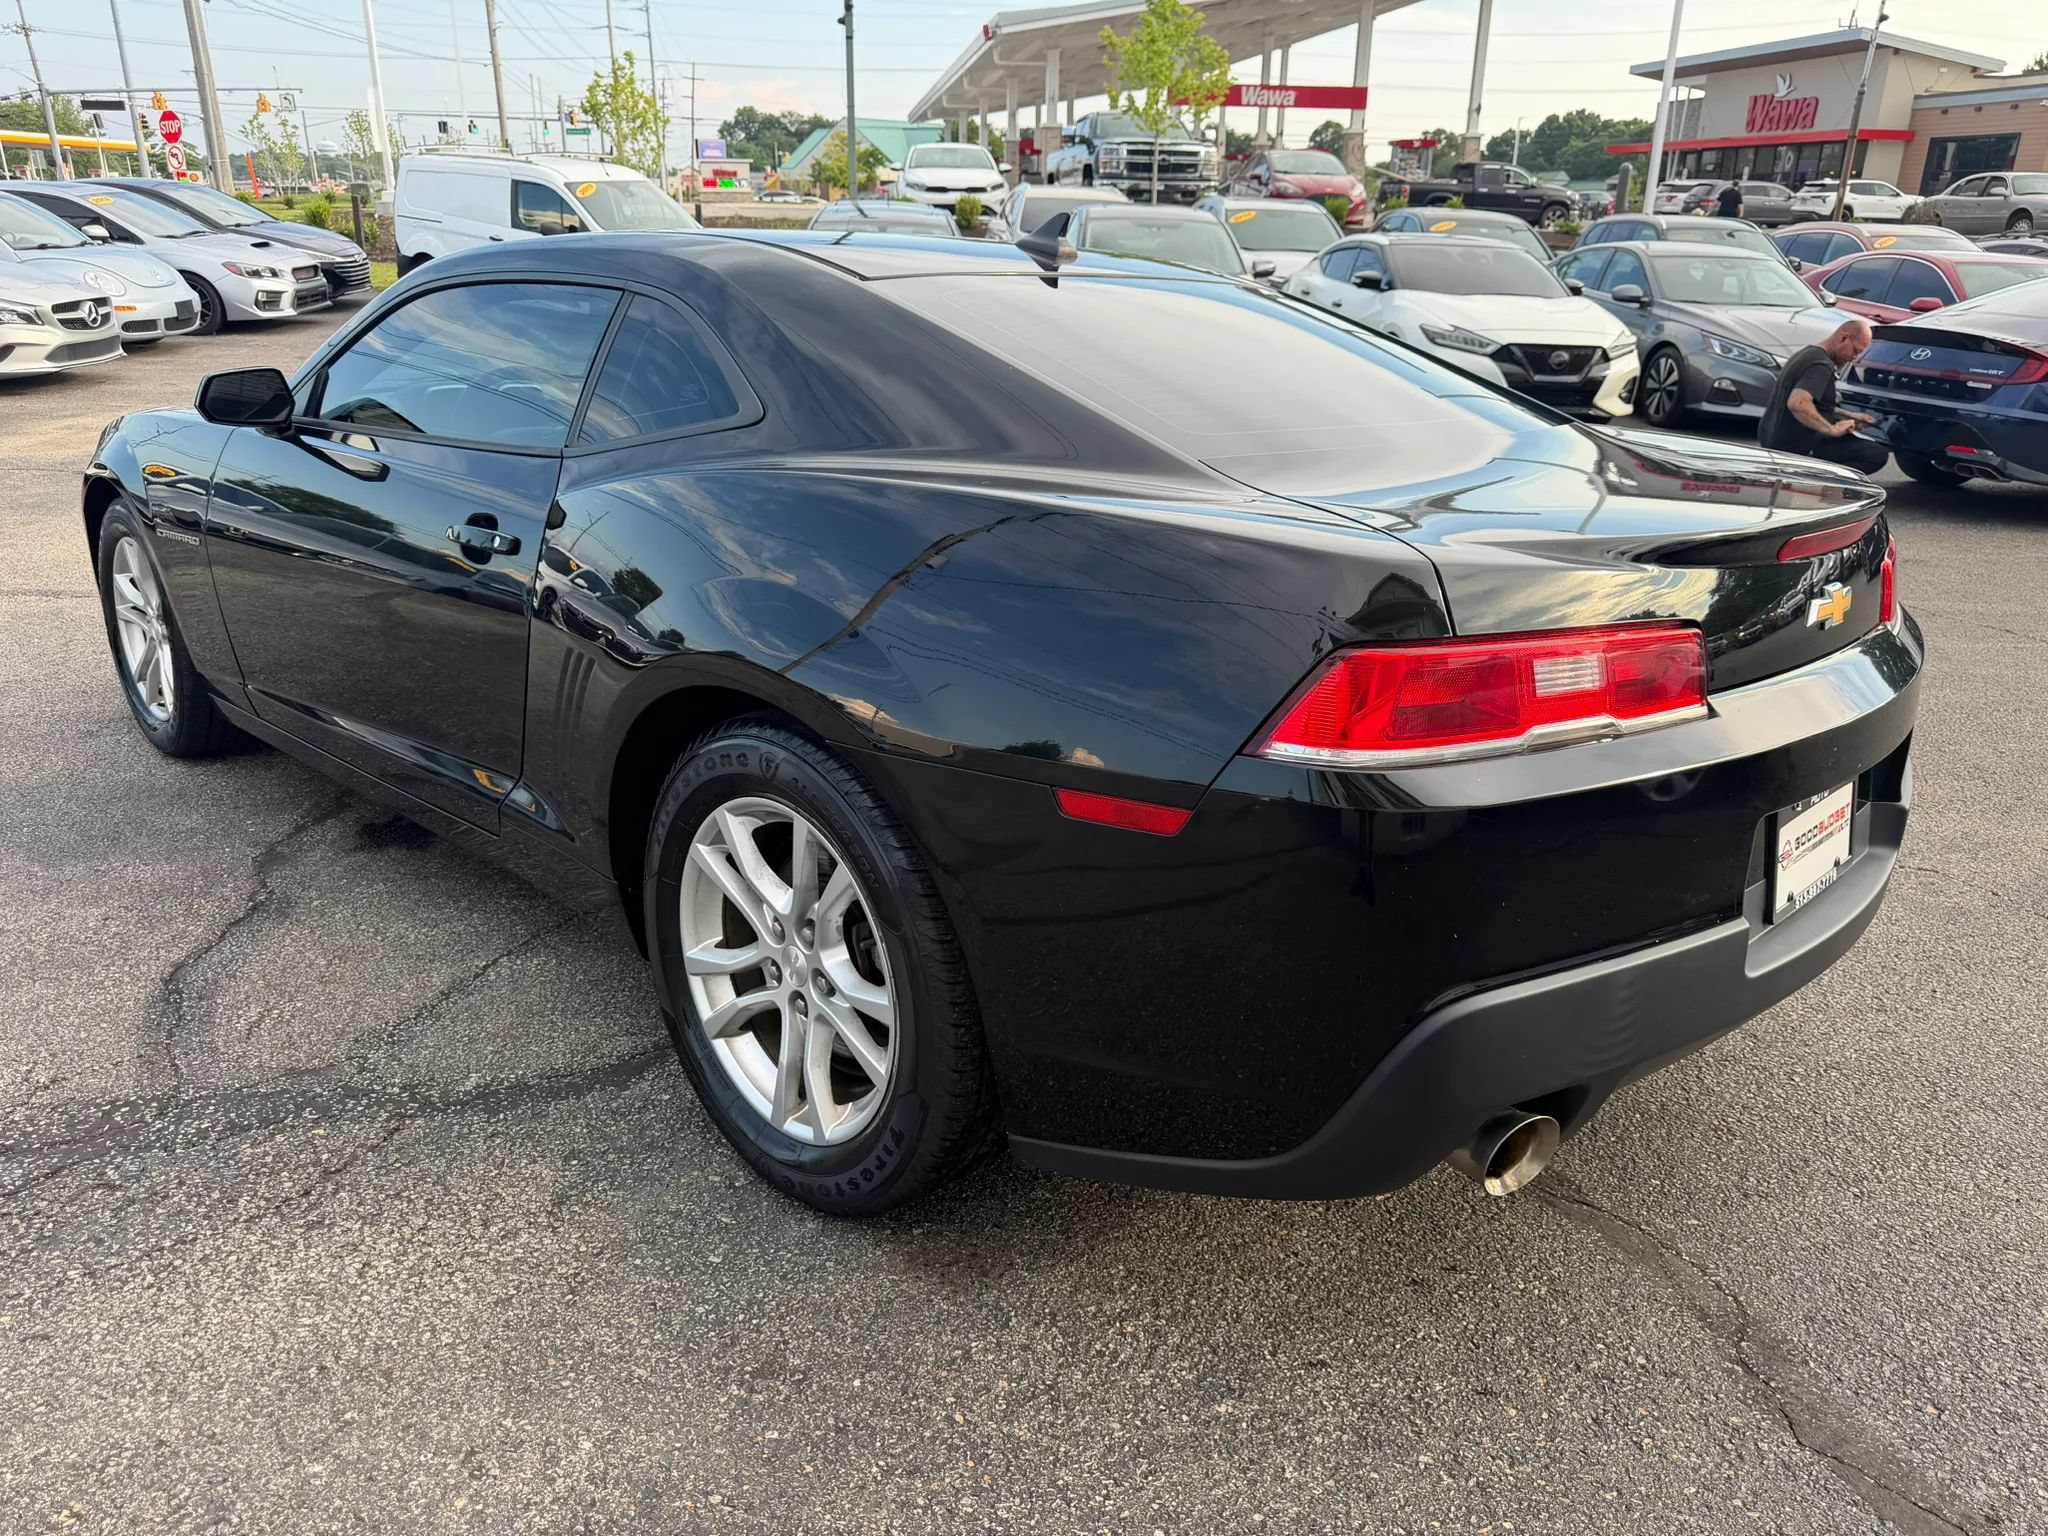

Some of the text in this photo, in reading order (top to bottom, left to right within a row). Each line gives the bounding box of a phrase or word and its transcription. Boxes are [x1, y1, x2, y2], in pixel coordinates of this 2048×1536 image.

[1240, 86, 1296, 106] Wawa
[1746, 94, 1819, 133] Wawa
[160, 119, 181, 135] STOP
[156, 528, 200, 546] CAMARO
[782, 1126, 905, 1198] Firestone
